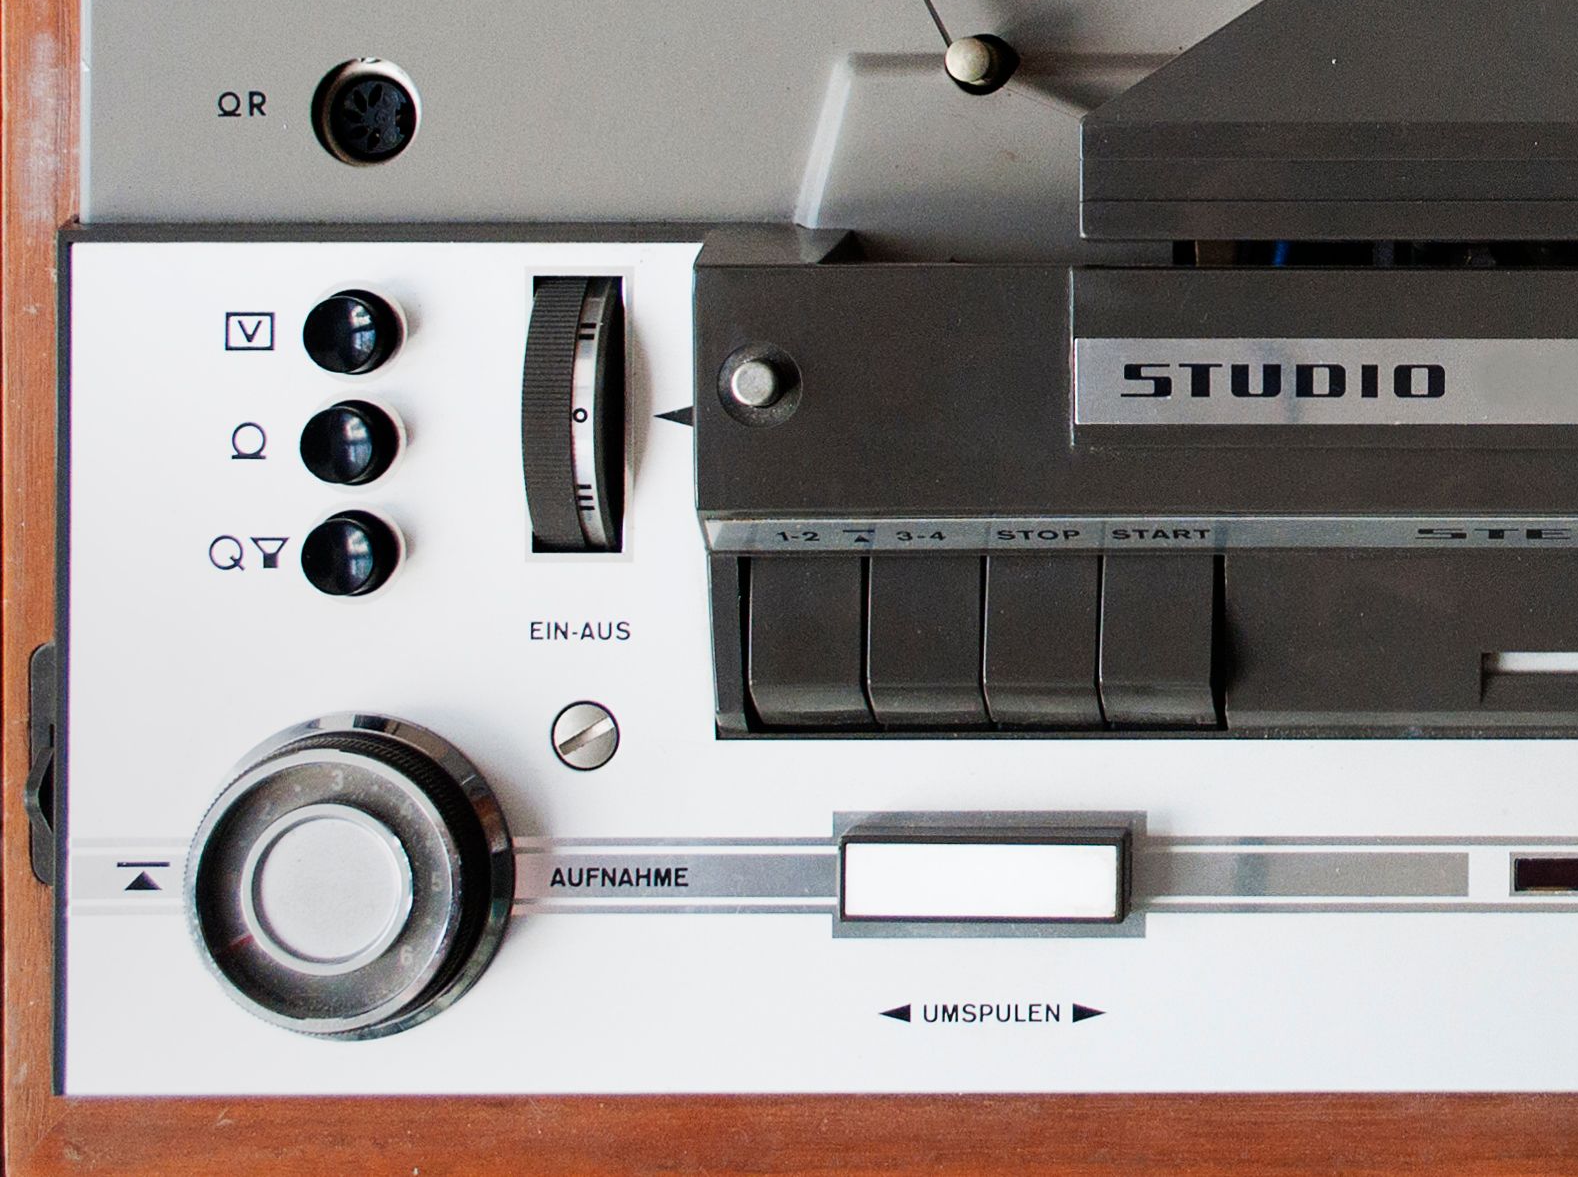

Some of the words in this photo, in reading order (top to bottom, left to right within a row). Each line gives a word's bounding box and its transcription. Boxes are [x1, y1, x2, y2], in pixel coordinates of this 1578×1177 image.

[1120, 363, 1447, 399] STUDIO
[776, 530, 821, 542] 1-2
[895, 529, 948, 542] 3-4
[997, 528, 1081, 541] STOP
[1111, 527, 1211, 540] START
[529, 621, 632, 642] EIN-AUS
[549, 866, 690, 889] AUFNAHME
[922, 1002, 1062, 1024] UMSPULEN
